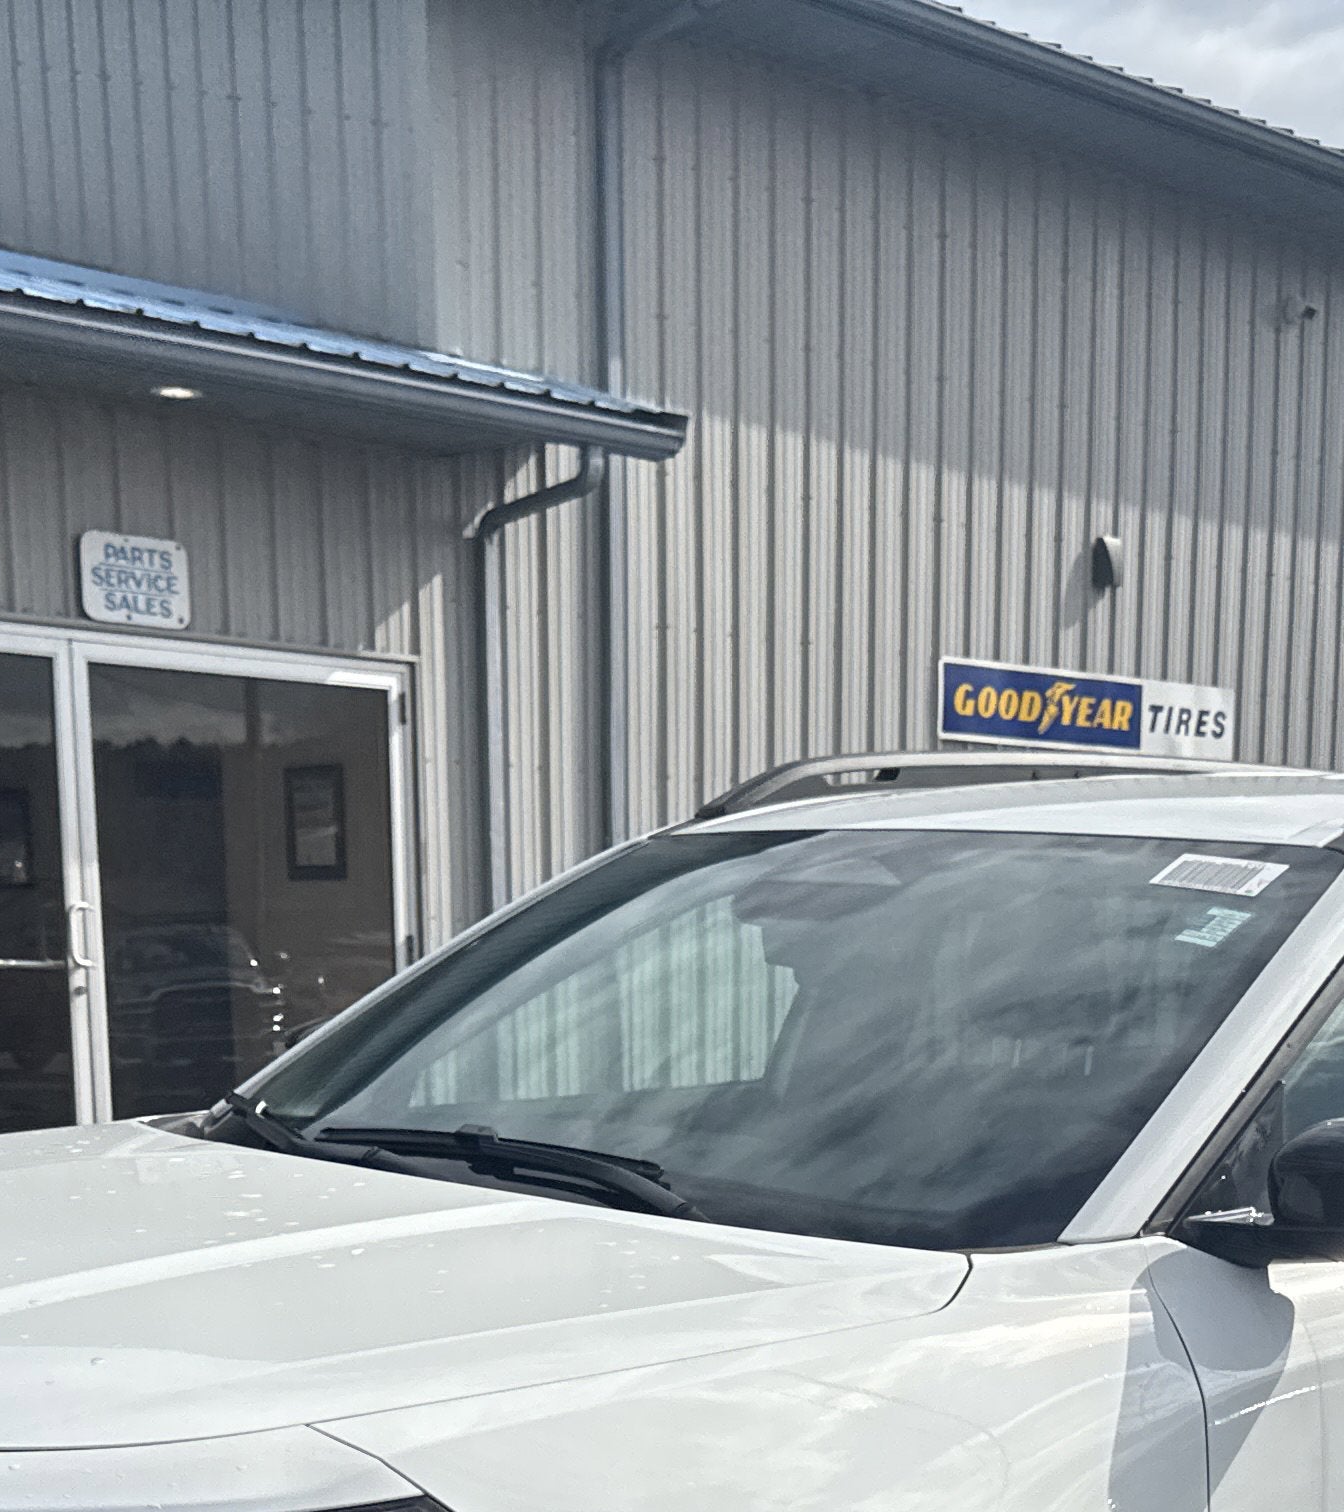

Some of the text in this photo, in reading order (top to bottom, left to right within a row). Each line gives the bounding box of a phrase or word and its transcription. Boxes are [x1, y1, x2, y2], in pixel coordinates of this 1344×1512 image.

[104, 544, 173, 570] PARTS
[91, 566, 179, 594] SERVICE
[104, 593, 173, 618] SALES
[1148, 704, 1227, 739] TIRES
